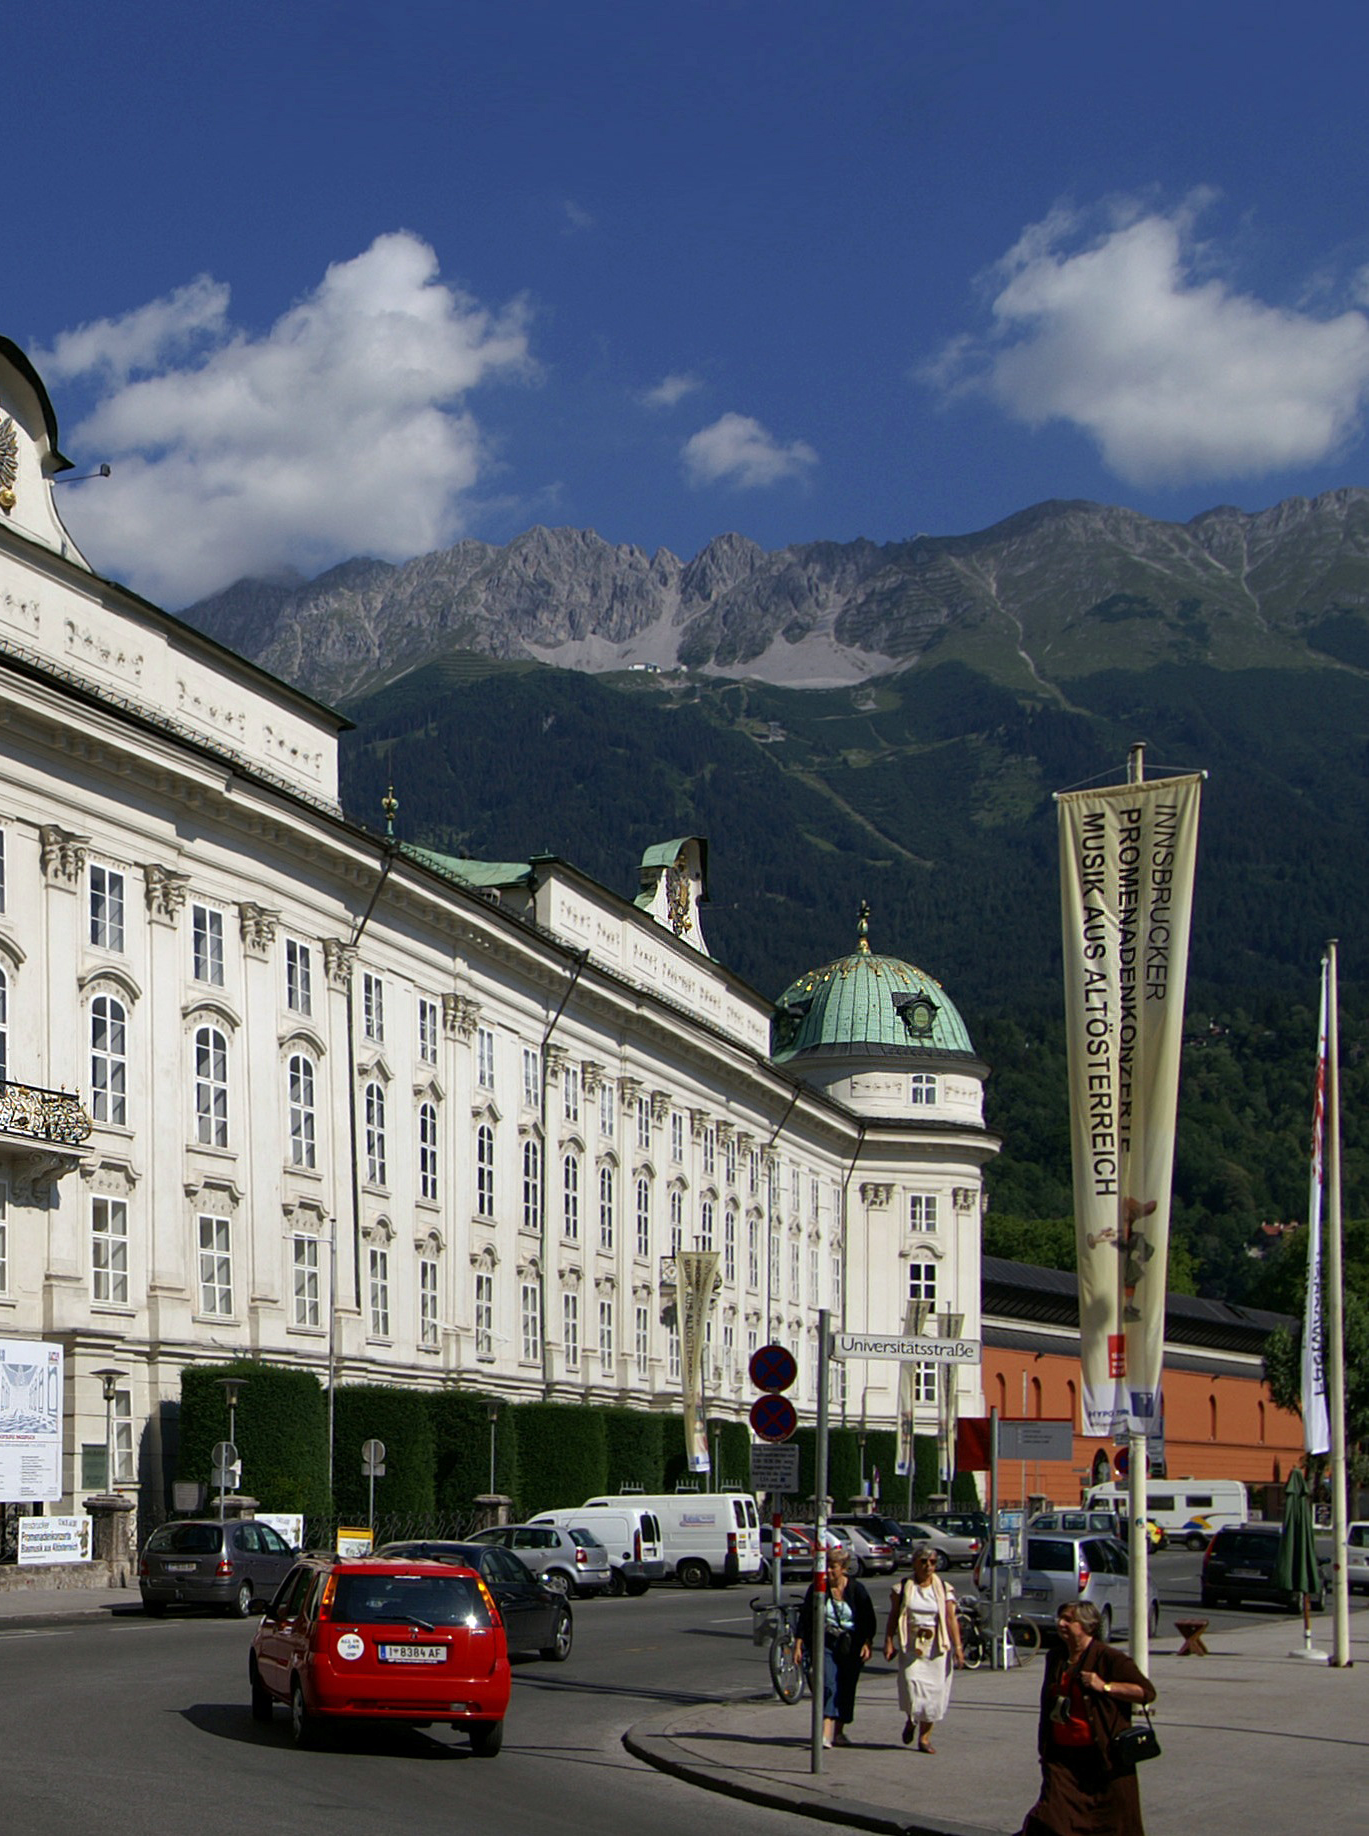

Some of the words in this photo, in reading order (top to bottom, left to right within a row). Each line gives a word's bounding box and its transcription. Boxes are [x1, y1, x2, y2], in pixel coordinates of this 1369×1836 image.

[1081, 812, 1106, 898] MUSIK
[1082, 905, 1107, 961] AUS
[1144, 804, 1178, 1001] INNSBRUCKER
[1083, 967, 1118, 1197] ALTÖSTERREICH
[840, 1336, 974, 1359] Universitätsstraße
[400, 1646, 426, 1658] 8384
[428, 1647, 442, 1659] AF
